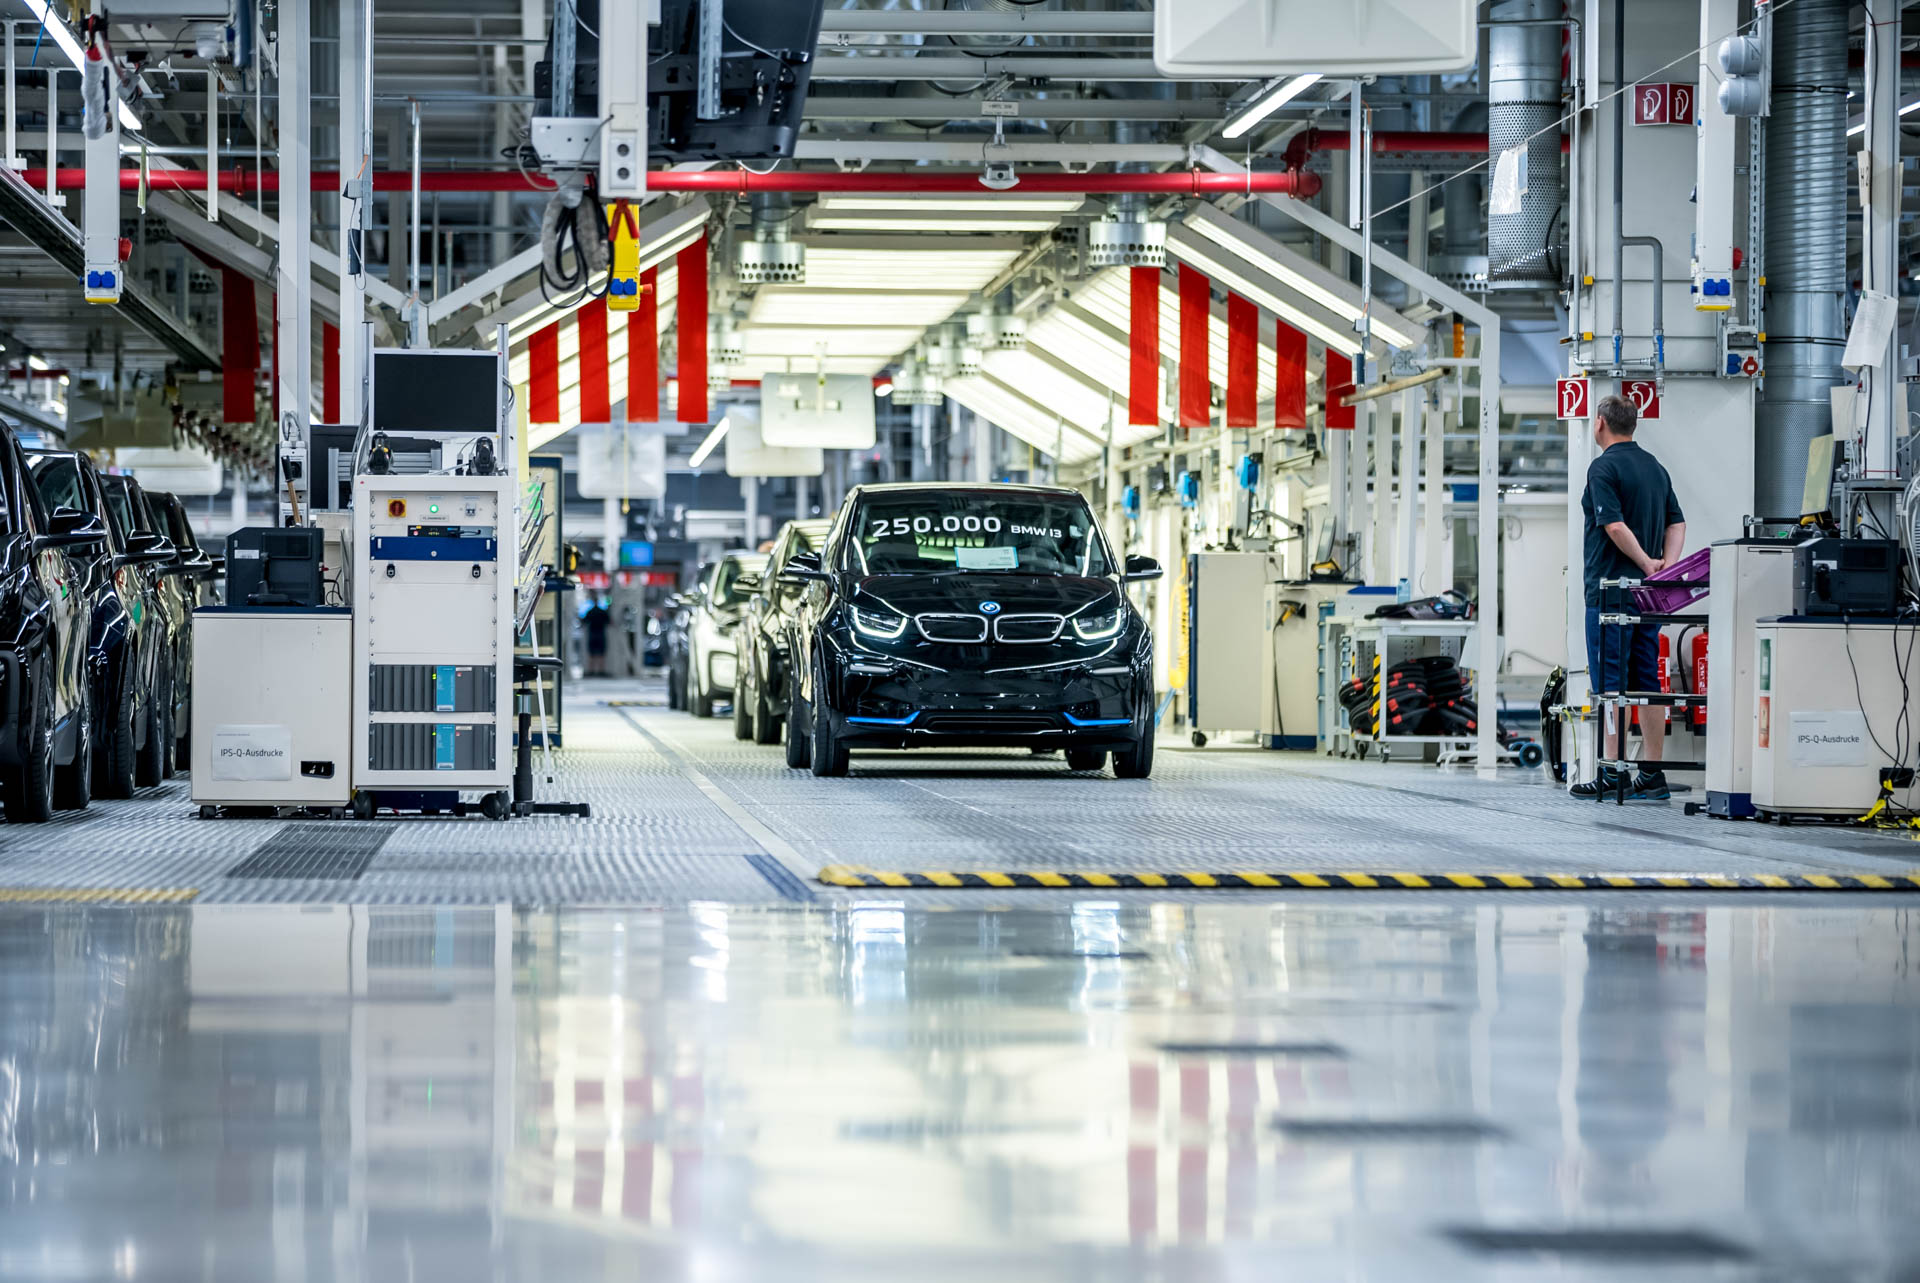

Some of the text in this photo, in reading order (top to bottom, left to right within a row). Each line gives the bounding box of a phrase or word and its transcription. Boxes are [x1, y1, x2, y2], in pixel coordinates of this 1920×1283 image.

[872, 516, 1001, 537] 250.000
[1010, 524, 1047, 537] BMW
[1798, 734, 1860, 744] IPS-Q-Ausdrucke
[220, 748, 284, 758] IPS-Q-Ausdrucke
